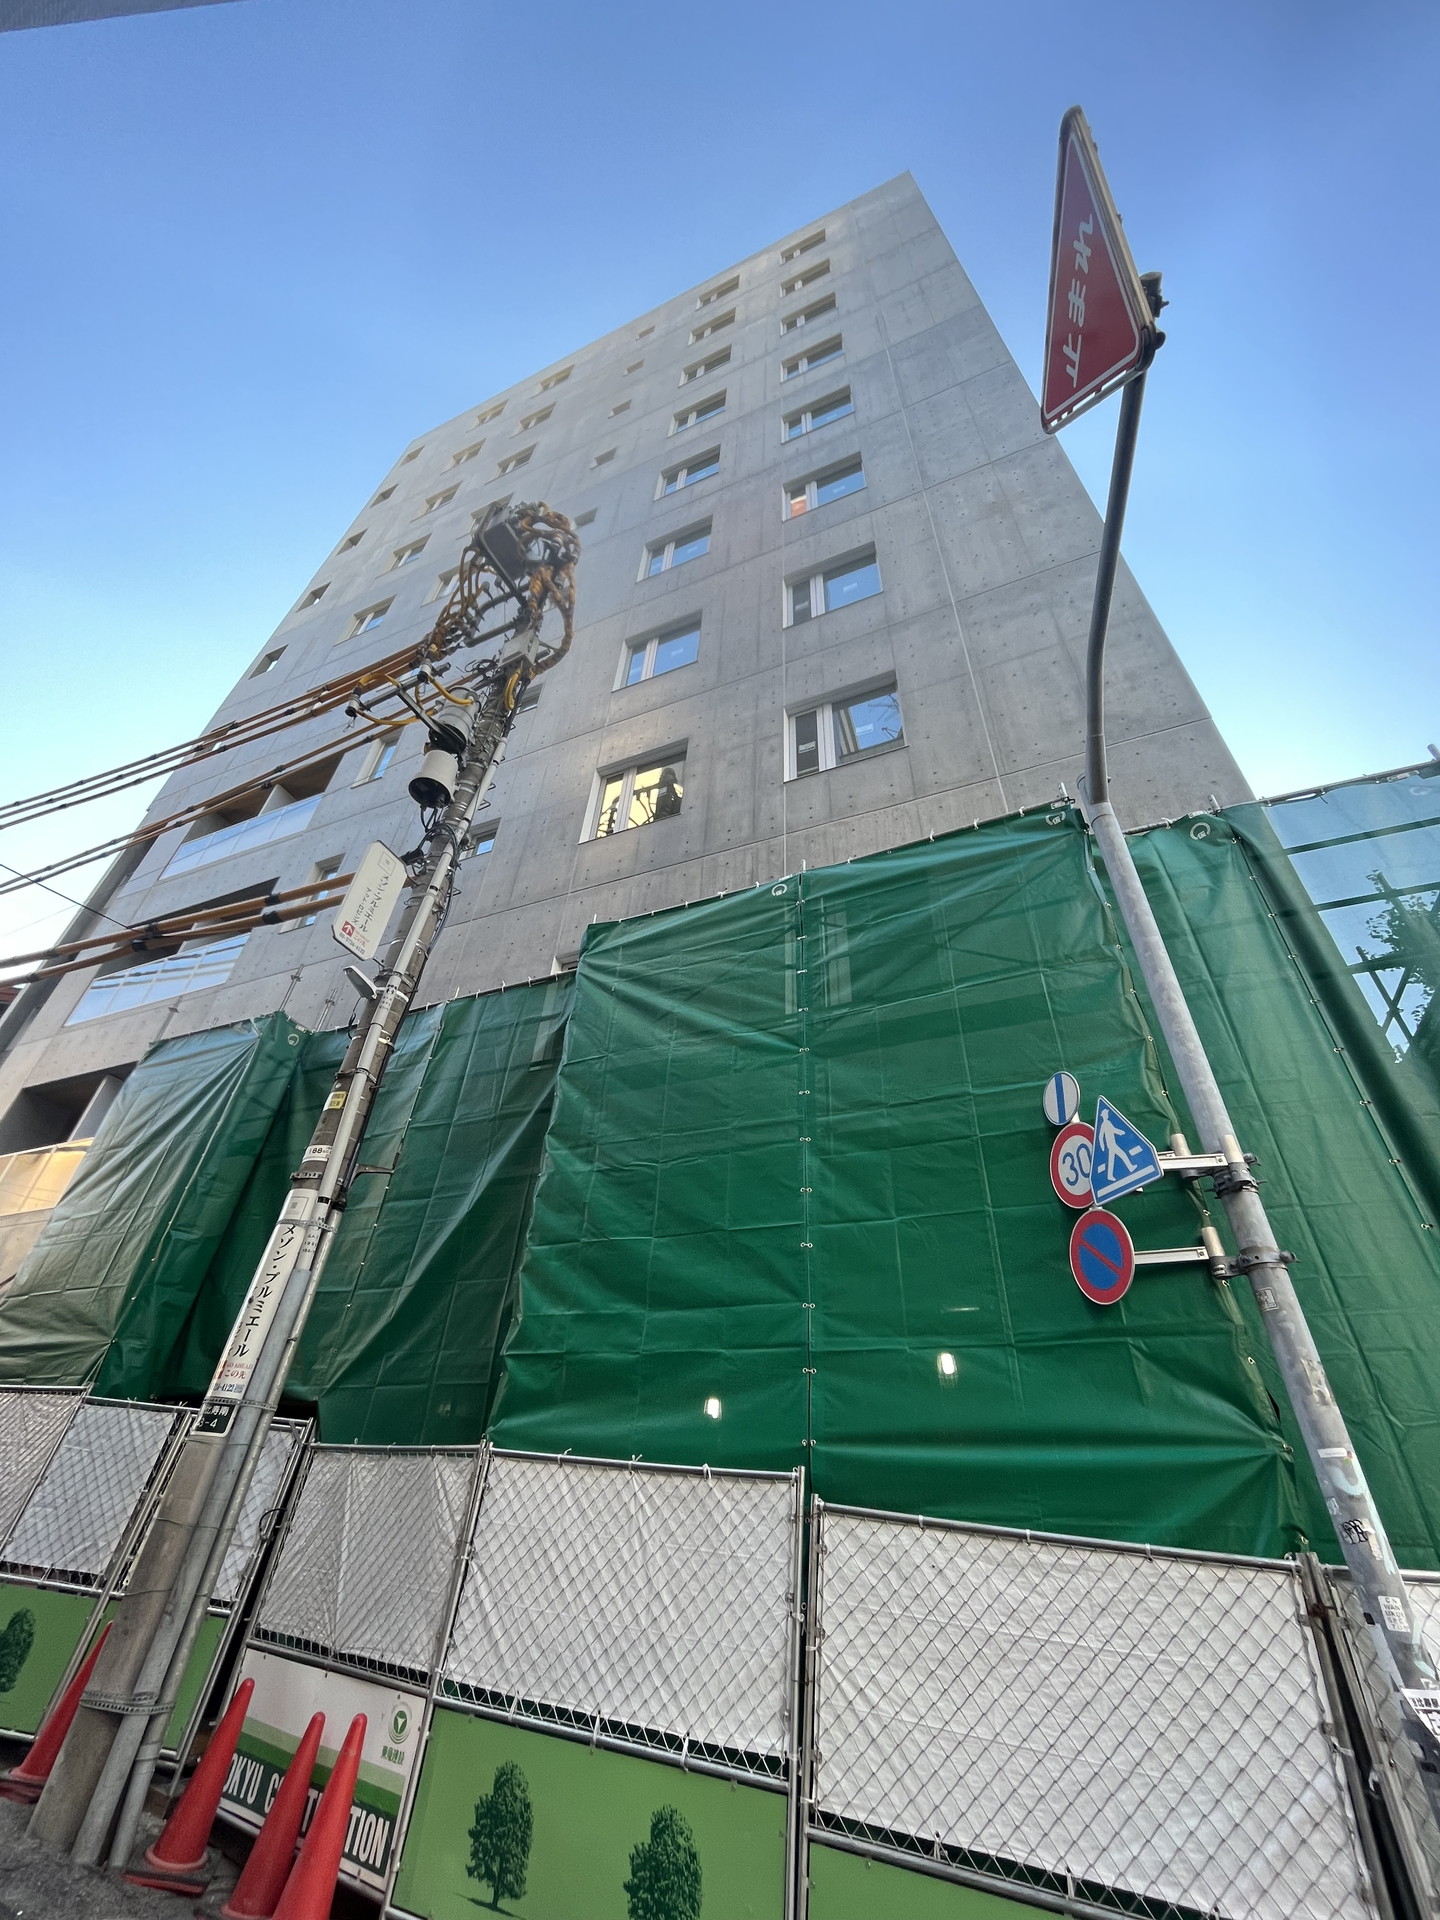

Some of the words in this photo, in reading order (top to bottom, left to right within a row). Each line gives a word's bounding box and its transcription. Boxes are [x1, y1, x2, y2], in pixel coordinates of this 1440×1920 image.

[1063, 213, 1093, 388] 止まれ
[1062, 1143, 1093, 1187] 30
[232, 1225, 296, 1358] メゾン・プルミエール
[224, 1369, 246, 1379] この先
[222, 1753, 264, 1805] OKYU
